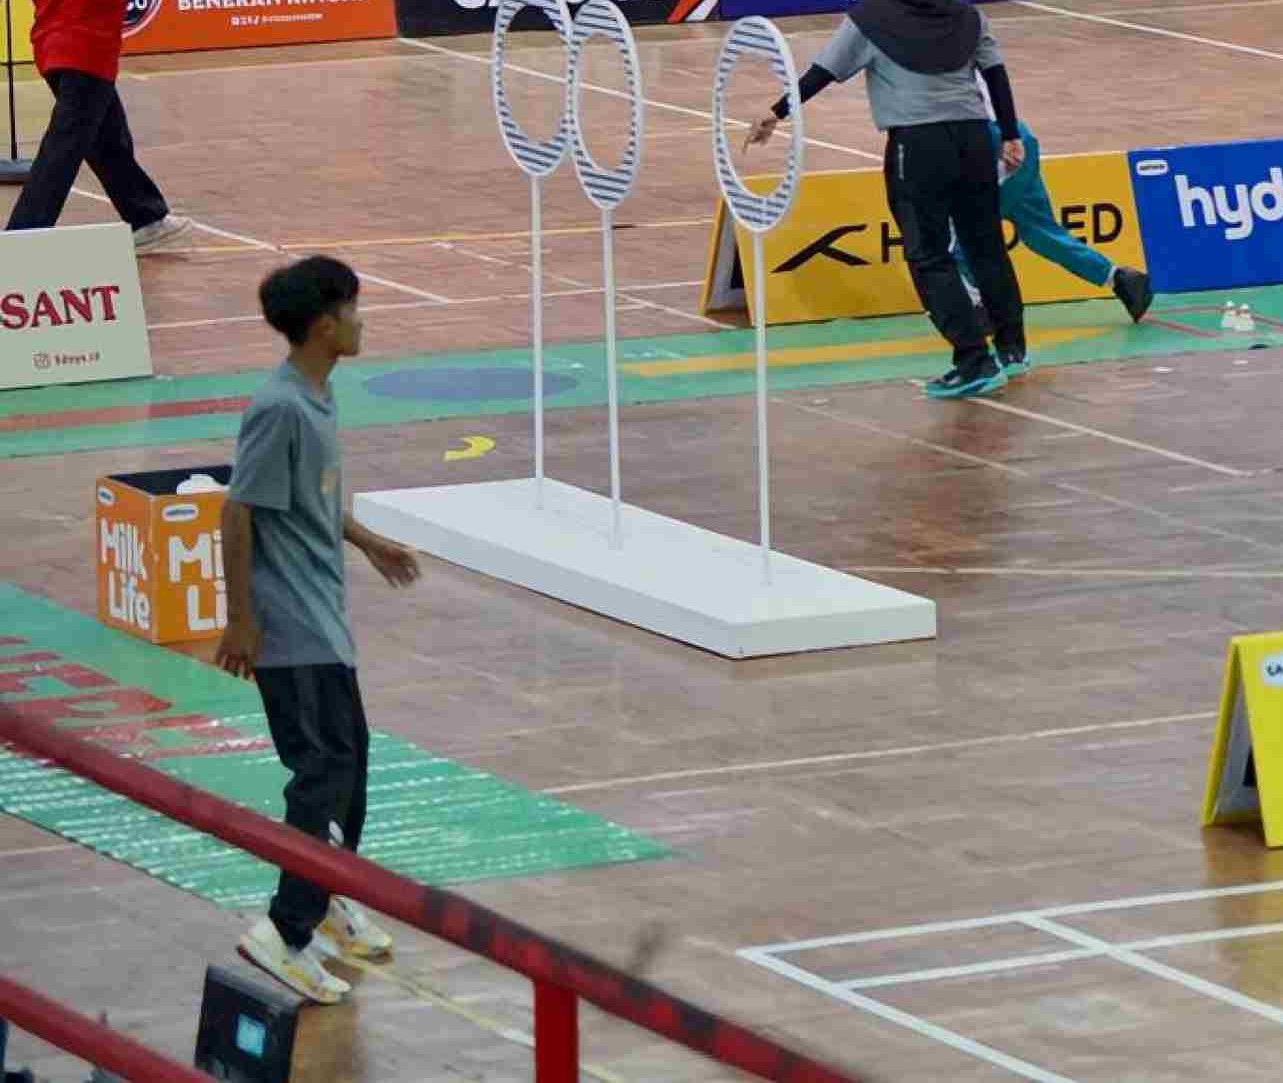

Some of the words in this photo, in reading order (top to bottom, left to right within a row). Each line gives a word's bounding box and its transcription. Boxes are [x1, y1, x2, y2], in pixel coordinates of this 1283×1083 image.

[100, 518, 147, 580] Milk
[168, 529, 224, 582] Mi
[109, 570, 150, 630] Life
[187, 581, 227, 630] Li
